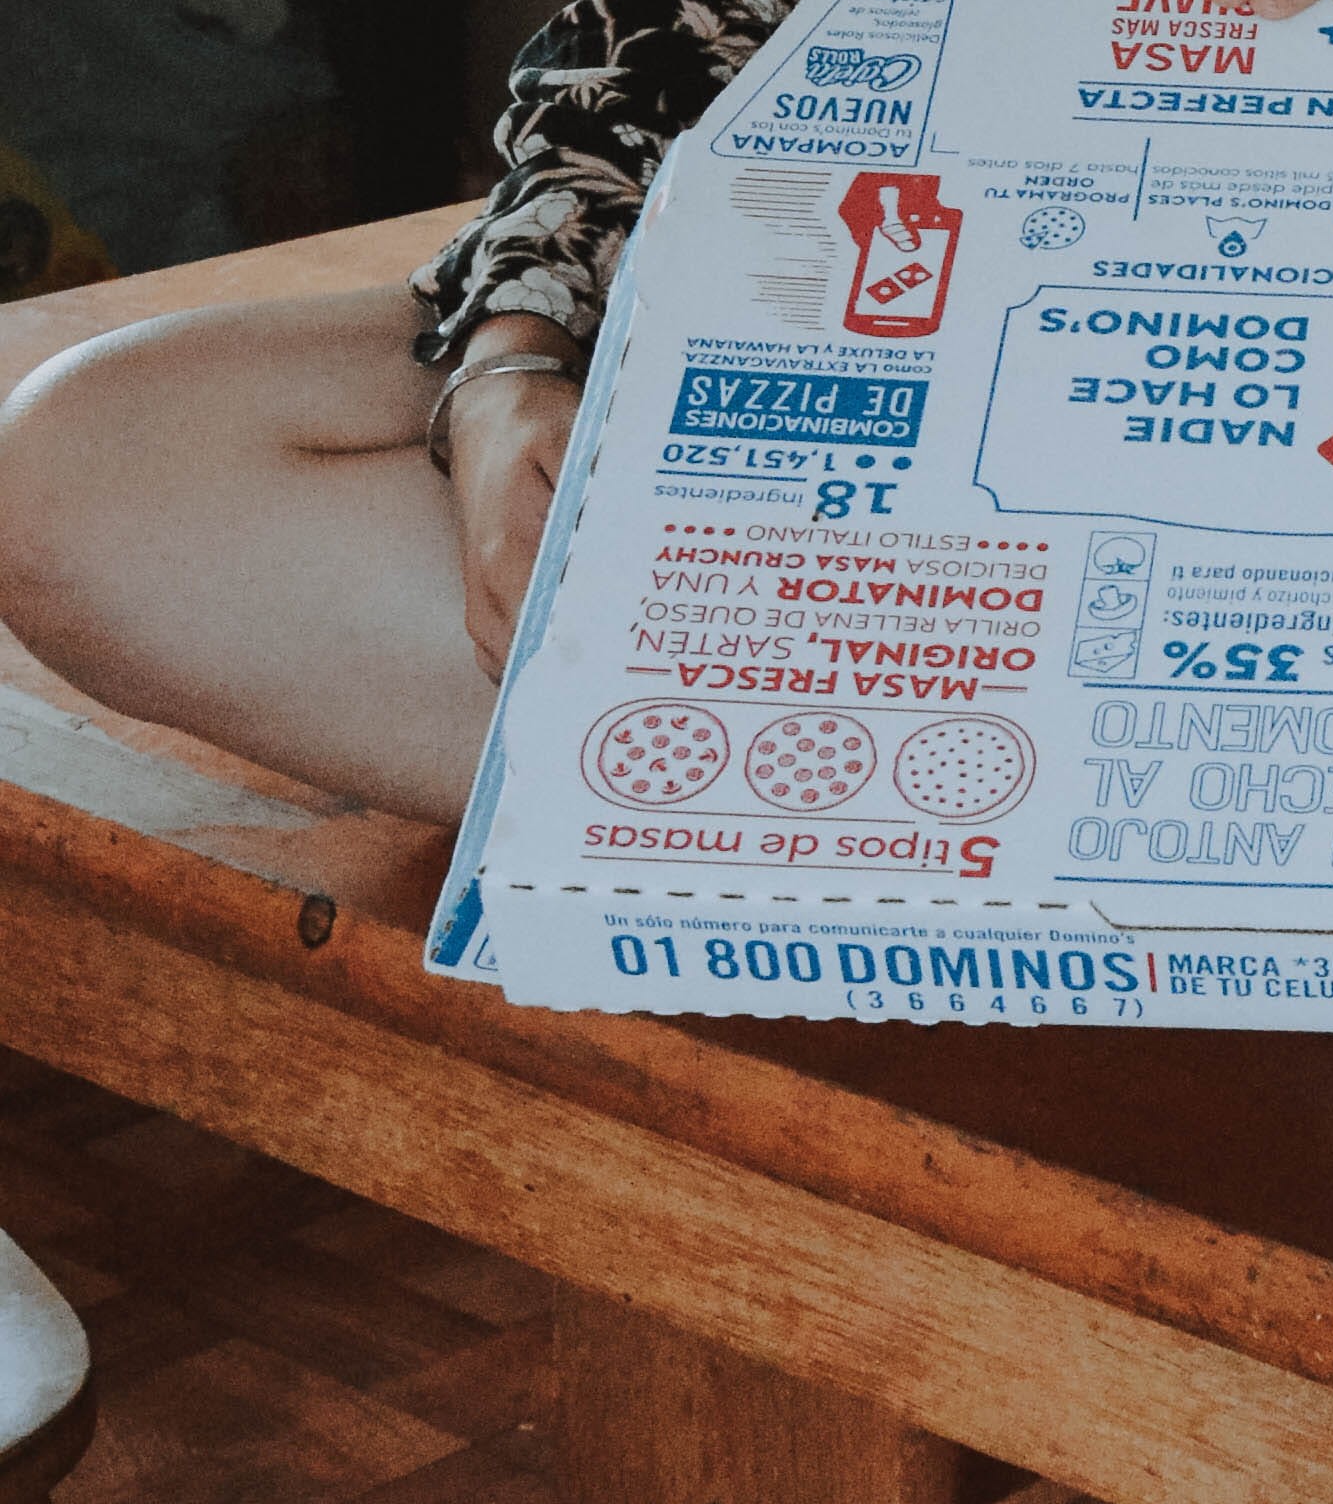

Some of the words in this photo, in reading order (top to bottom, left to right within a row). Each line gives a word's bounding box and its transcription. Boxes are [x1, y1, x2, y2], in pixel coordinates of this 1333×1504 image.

[1112, 18, 1159, 39] MÁS
[1169, 21, 1257, 39] FRESCA
[809, 49, 860, 64] ROLLS
[1109, 40, 1256, 75] MASA
[773, 94, 912, 125] NUEVOS
[1077, 87, 1294, 116] PERFECTA
[732, 134, 909, 158] ACOMPAÑA
[1038, 307, 1308, 340] DOMINO'S
[1147, 345, 1304, 372] COMO
[688, 375, 839, 413] PIZZAS
[863, 385, 914, 416] DE
[1068, 377, 1216, 407] HACE
[1234, 383, 1299, 409] LO
[685, 409, 910, 438] COMBINACIONES
[1124, 415, 1295, 446] NADIE
[662, 444, 836, 472] 1,451,520
[654, 485, 803, 508] ingredientes
[817, 481, 898, 519] 18
[747, 525, 871, 546] ITALIANO
[879, 533, 970, 550] ESTILO
[655, 546, 805, 569] CRUNCHY
[817, 554, 896, 574] MASA
[908, 560, 1047, 580] DELICIOSA
[1193, 564, 1234, 580] para
[651, 570, 729, 594] UNA
[737, 576, 758, 596] Y
[1172, 566, 1185, 581] ti
[777, 578, 1044, 612] DOMINATOR
[640, 597, 756, 626] QUESO,
[767, 609, 805, 628] DE
[815, 612, 936, 633] RELLENA
[629, 623, 794, 660] SARTÉN,
[944, 618, 1040, 637] ORILLA
[807, 632, 1036, 670] ORIGINAL,
[1163, 640, 1304, 682] 35%
[678, 663, 838, 695] FRESCA
[853, 673, 978, 700] MASA
[1084, 758, 1162, 808] AL
[585, 824, 742, 854] masas
[760, 833, 819, 863] de
[836, 832, 950, 867] tipos
[1068, 817, 1304, 866] ANTOJO
[959, 836, 1000, 878] 5
[605, 914, 628, 927] Un
[681, 917, 752, 933] número
[760, 920, 800, 934] para
[808, 924, 927, 938] comunicarte
[936, 929, 946, 939] a
[954, 927, 1042, 942] cualquier
[1050, 929, 1135, 945] Domino's
[611, 934, 681, 977] 01
[705, 939, 821, 983] 800
[838, 943, 1138, 992] DOMINOS
[1169, 954, 1278, 977] MARCA
[1169, 977, 1210, 996] DE
[1219, 977, 1252, 996] TU
